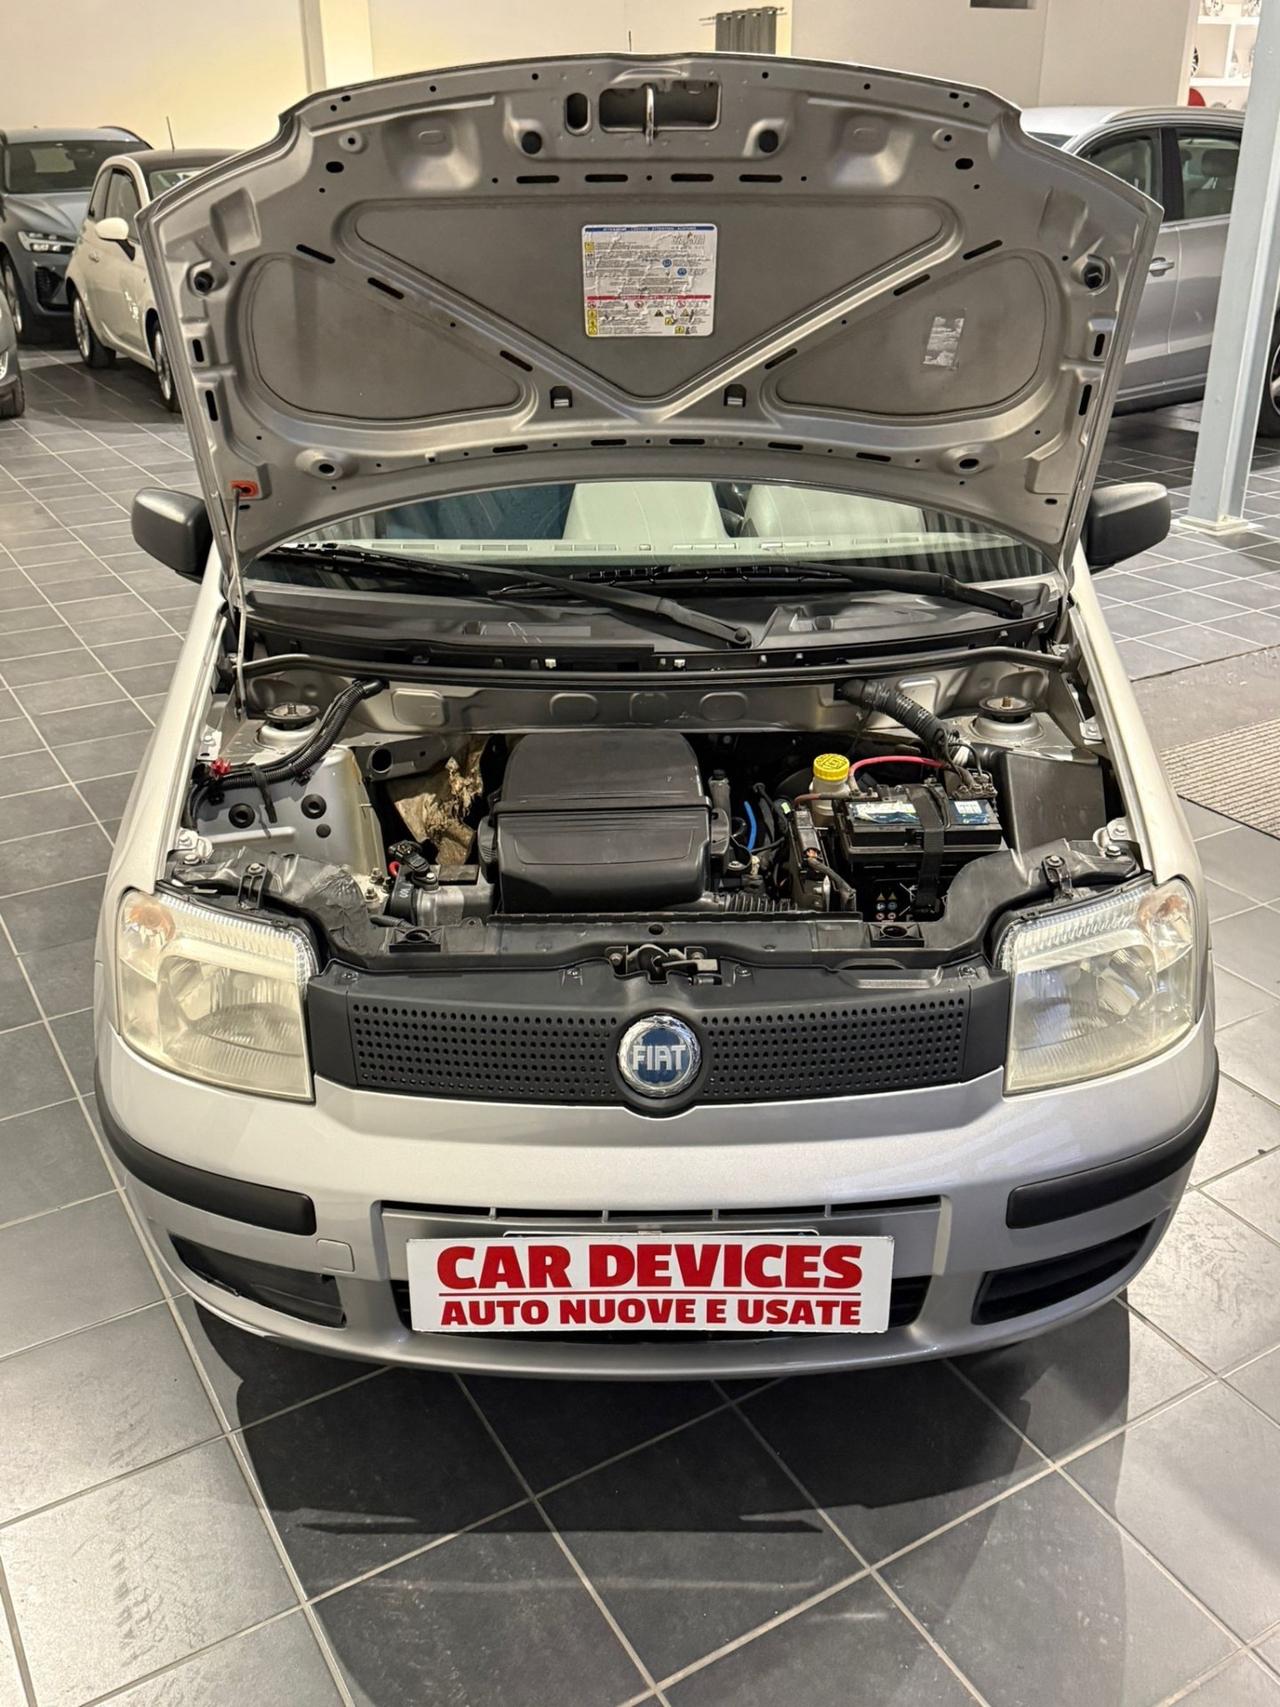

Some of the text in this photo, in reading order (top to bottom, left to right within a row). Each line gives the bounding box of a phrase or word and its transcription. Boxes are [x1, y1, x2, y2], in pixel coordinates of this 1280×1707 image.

[632, 1045, 687, 1071] FIAT
[436, 1243, 863, 1291] CAR DEVICES
[440, 1297, 862, 1327] AUTO NUOVE E USATE
